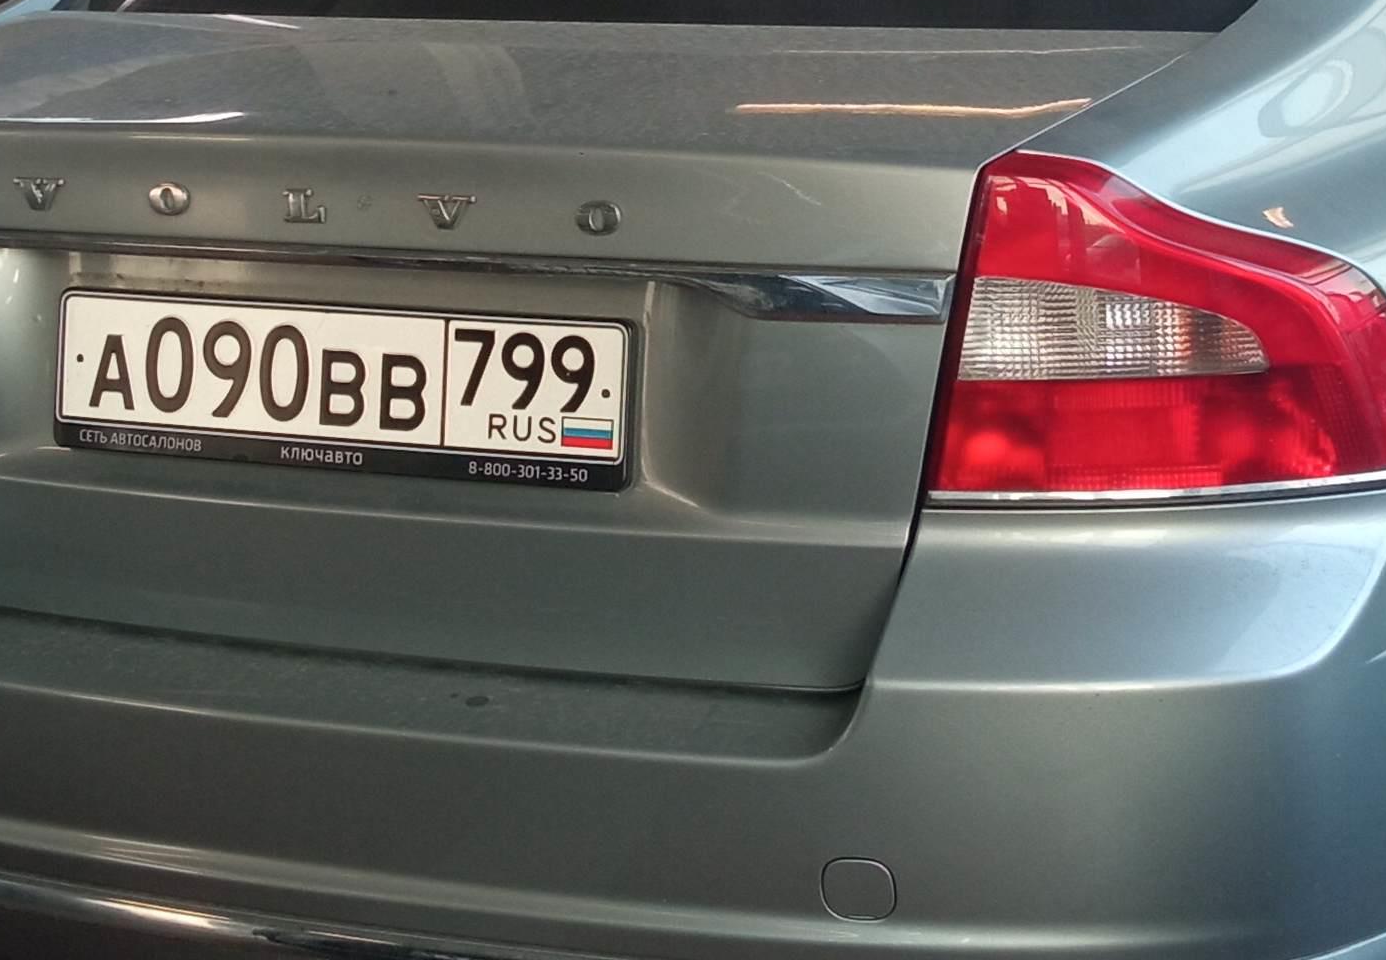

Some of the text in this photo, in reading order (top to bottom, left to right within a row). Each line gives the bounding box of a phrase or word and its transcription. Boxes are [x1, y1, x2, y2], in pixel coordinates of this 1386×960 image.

[14, 176, 623, 237] VOLVO
[453, 327, 597, 413] 799
[79, 428, 203, 452] СЕТЬ АВТОСАЛОНОВ
[487, 413, 557, 444] RUS
[468, 460, 589, 483] 8-800-301-33-50
